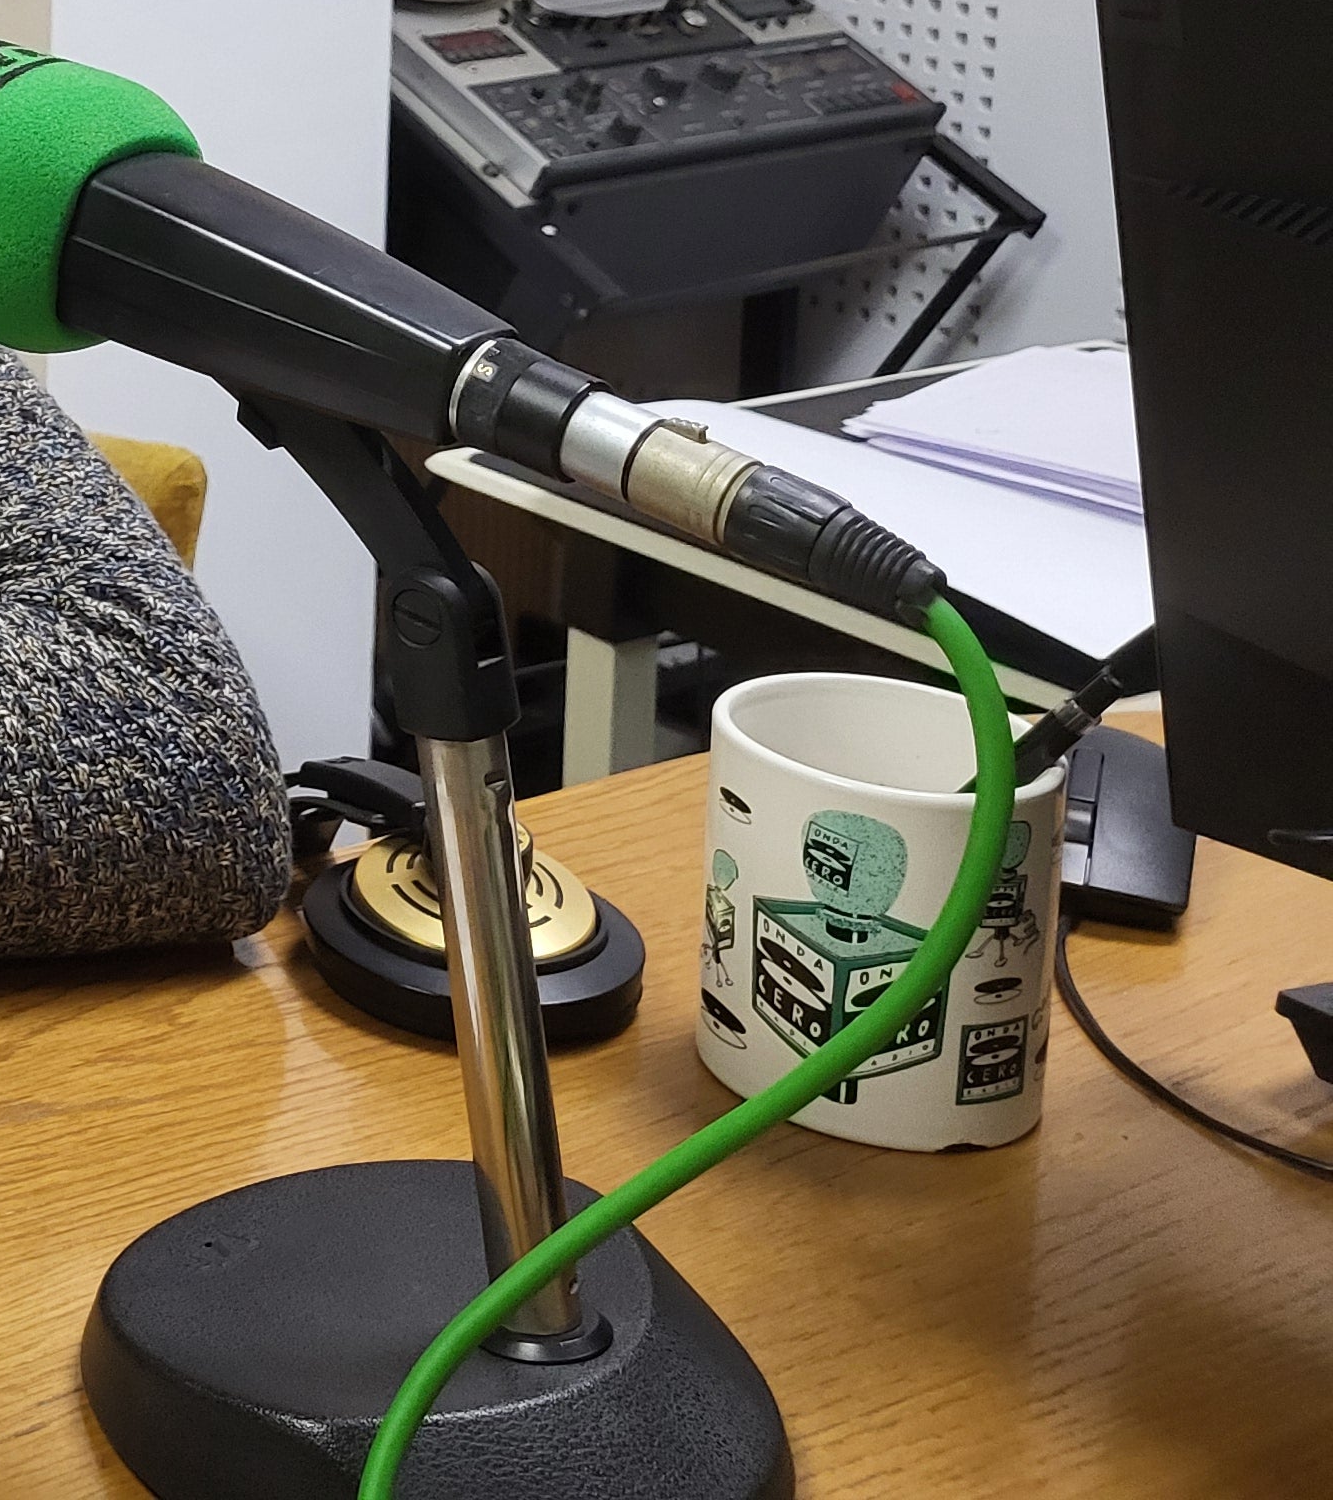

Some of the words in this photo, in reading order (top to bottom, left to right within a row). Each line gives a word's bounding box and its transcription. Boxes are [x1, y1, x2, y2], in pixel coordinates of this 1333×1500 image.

[814, 828, 849, 850] ONDA
[804, 856, 844, 886] CERO
[762, 918, 824, 971] ONDA
[859, 967, 893, 986] ON
[758, 974, 822, 1038] CERO
[974, 1021, 1021, 1041] ONDA
[871, 1044, 930, 1067] ADIO
[966, 1062, 1018, 1084] CERO
